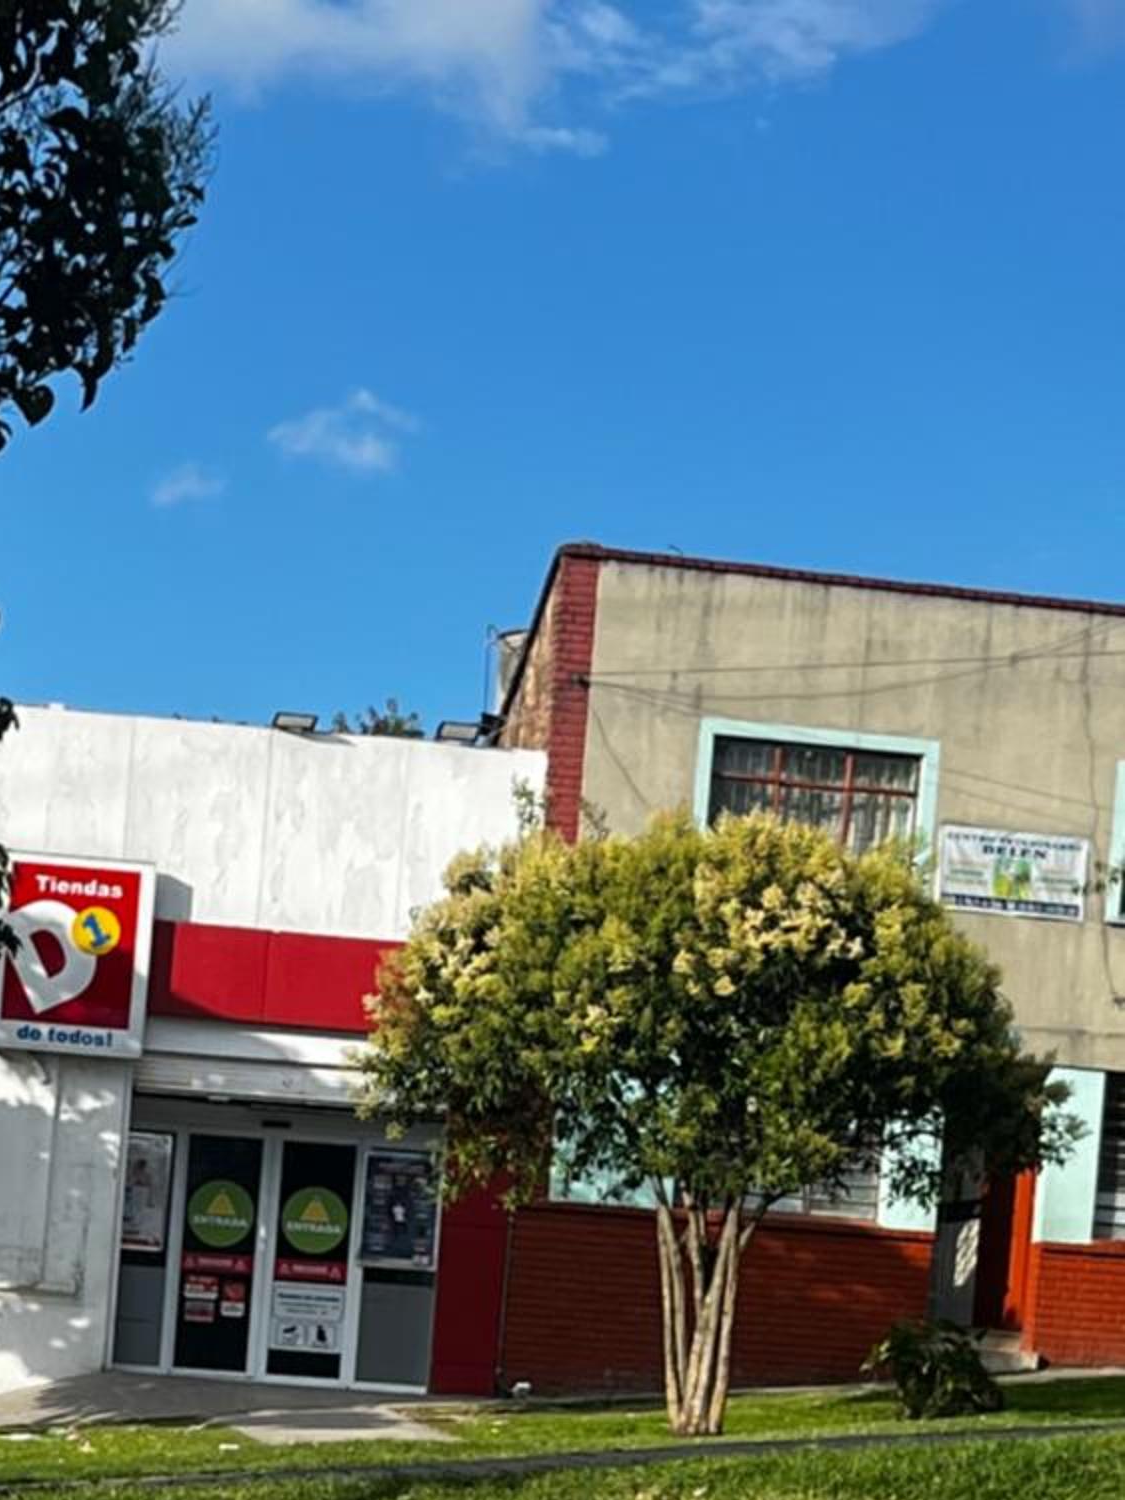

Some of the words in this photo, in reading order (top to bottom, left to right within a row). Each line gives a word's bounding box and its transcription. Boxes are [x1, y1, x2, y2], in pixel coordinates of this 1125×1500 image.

[35, 874, 124, 899] Tiendas
[16, 1025, 41, 1042] de
[48, 1027, 113, 1047] todos!
[193, 1215, 249, 1229] ENTRADA
[286, 1220, 342, 1234] ENTRADA
